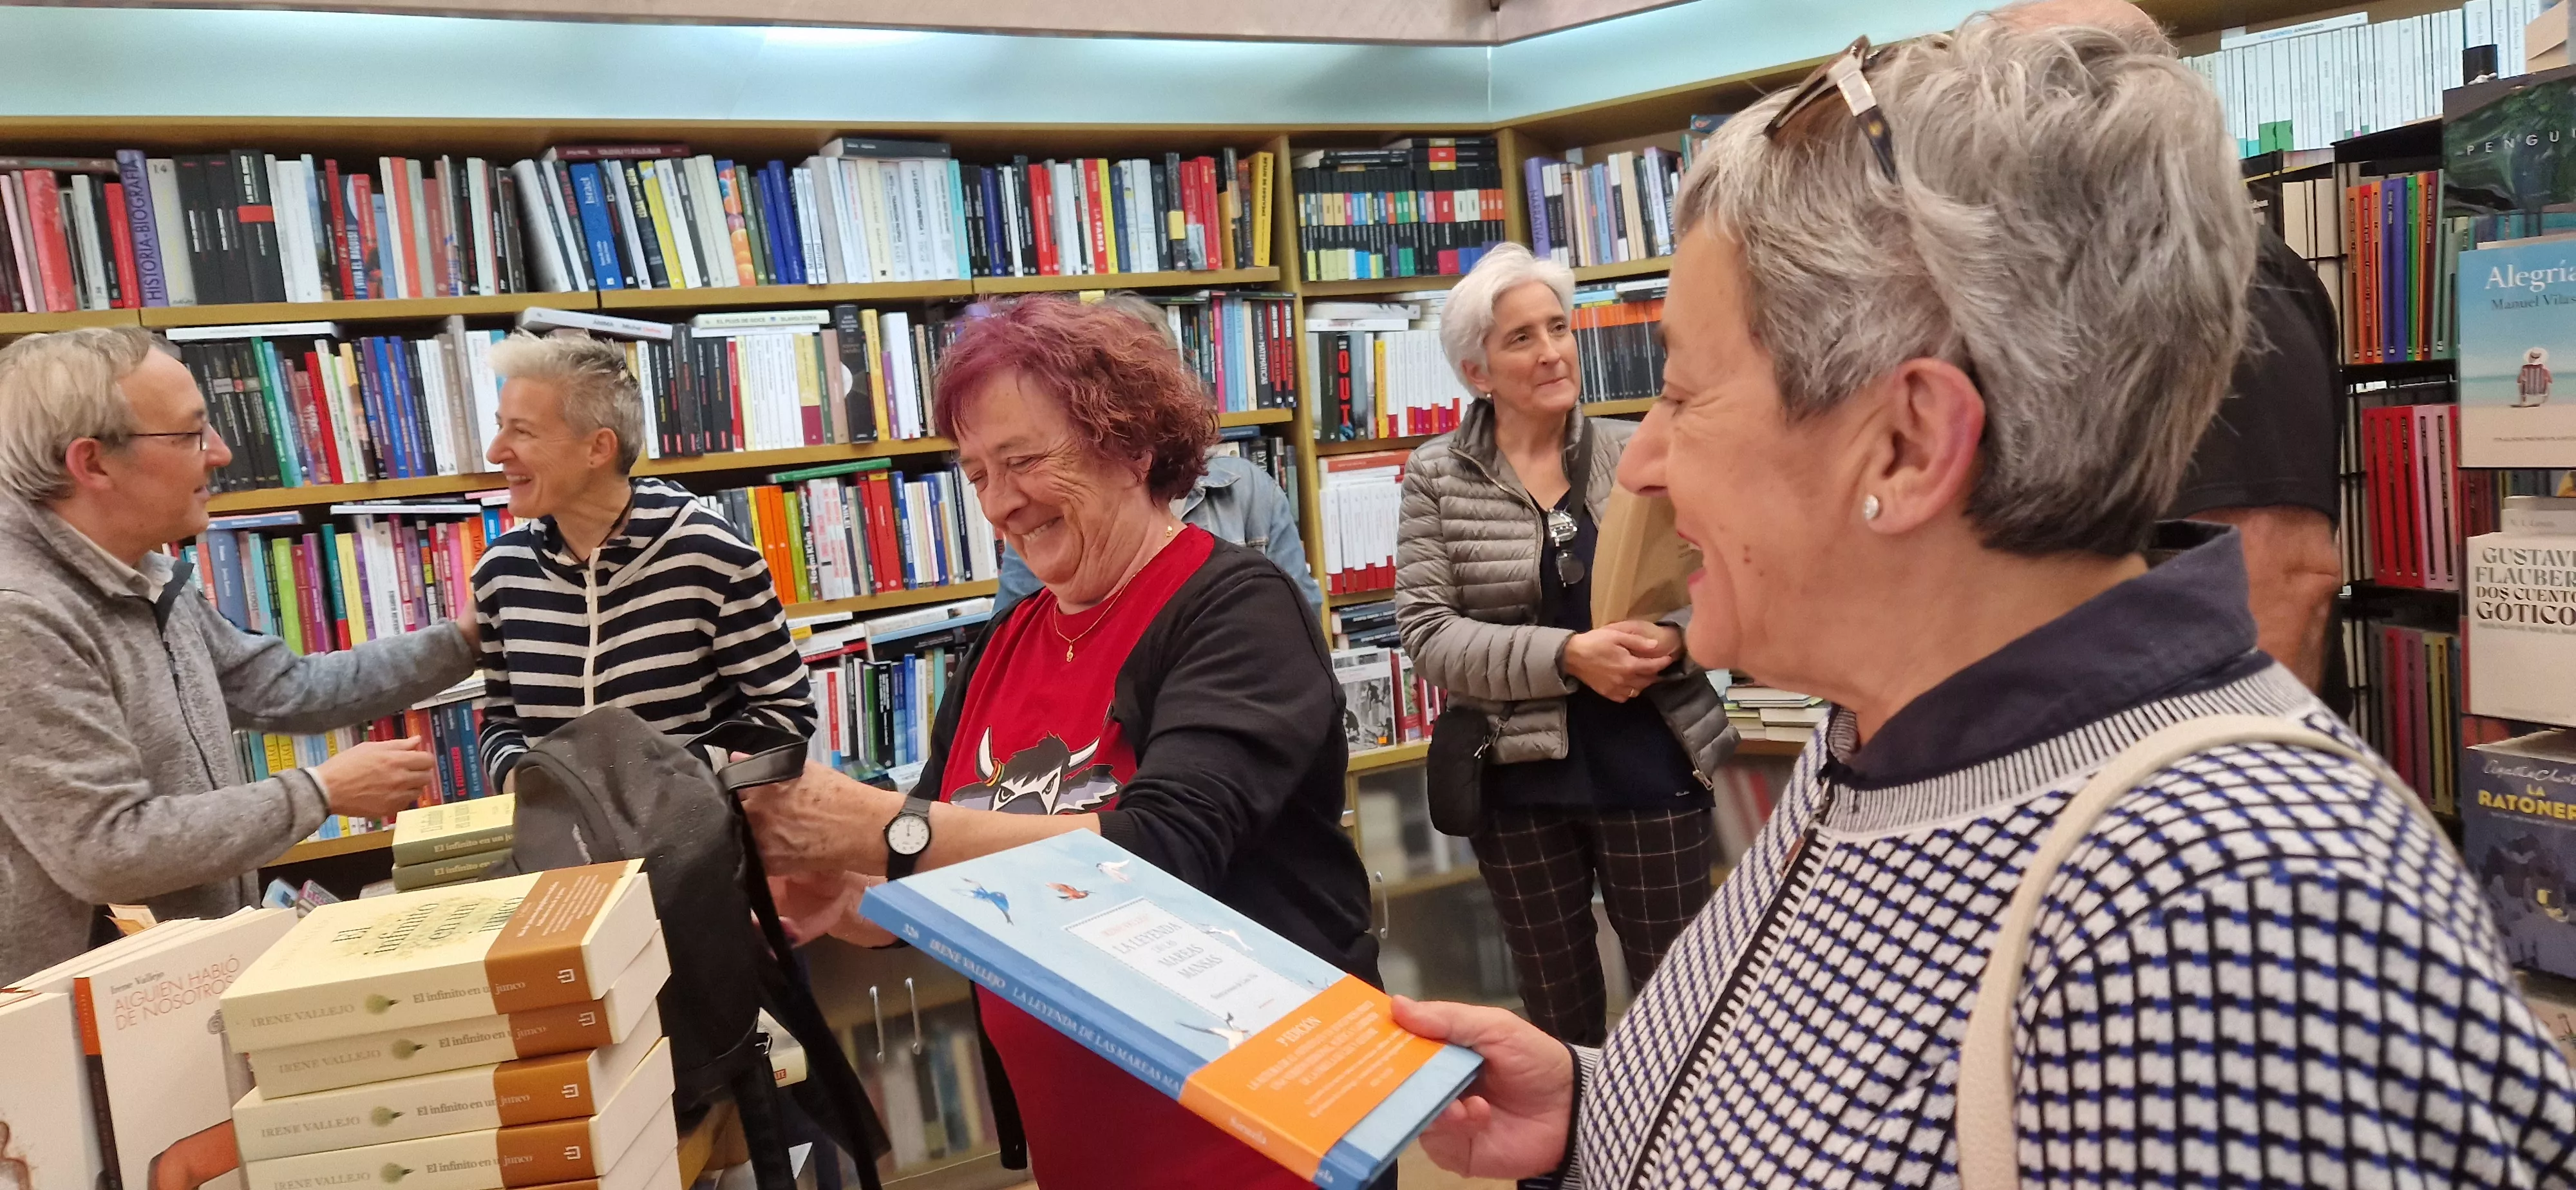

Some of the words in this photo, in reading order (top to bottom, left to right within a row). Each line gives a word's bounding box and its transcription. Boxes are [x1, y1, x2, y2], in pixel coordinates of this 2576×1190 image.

[2491, 296, 2539, 310] Manuel
[2476, 586, 2509, 600] DOS
[2526, 784, 2545, 797] LA
[446, 840, 478, 851] infinito
[446, 863, 478, 873] infinito
[1113, 940, 1132, 954] LA
[1131, 921, 1182, 949] LEYENDA
[1159, 943, 1204, 968] MAREAS
[1177, 954, 1222, 979] MANSAS
[115, 978, 183, 1014] ALGUIEN
[188, 954, 240, 985] HABLÓ
[116, 1010, 137, 1030] DE
[143, 976, 233, 1020] NOSOTROS
[251, 1014, 293, 1028] IRENE
[294, 1005, 355, 1020] VALLEJO
[413, 993, 424, 1003] El
[427, 988, 466, 1002] infinito
[467, 987, 480, 996] en
[495, 981, 526, 996] junco
[930, 940, 961, 963] IRENE
[963, 958, 1006, 989] VALLEJO
[1012, 988, 1027, 1003] LA
[1028, 997, 1077, 1032] LEYENDA
[1078, 1025, 1095, 1041] DE
[1095, 1034, 1115, 1054] LAS
[1117, 1045, 1160, 1079] MAREAS
[279, 1059, 320, 1073] IRENE
[321, 1049, 381, 1065] VALLEJO
[439, 1038, 450, 1048] El
[452, 1033, 491, 1046] infinito
[492, 1032, 506, 1040] en
[516, 1025, 547, 1040] junco
[261, 1124, 301, 1137] IRENE
[303, 1117, 360, 1131] VALLEJO
[417, 1107, 428, 1116] El
[430, 1102, 469, 1115] infinito
[470, 1100, 483, 1109] en
[500, 1095, 531, 1107] junco
[274, 1178, 314, 1190] IRENE
[315, 1172, 371, 1186] VALLEJO
[426, 1164, 437, 1173] El
[439, 1159, 477, 1172] infinito
[478, 1158, 491, 1167] en
[503, 1155, 533, 1167] junco
